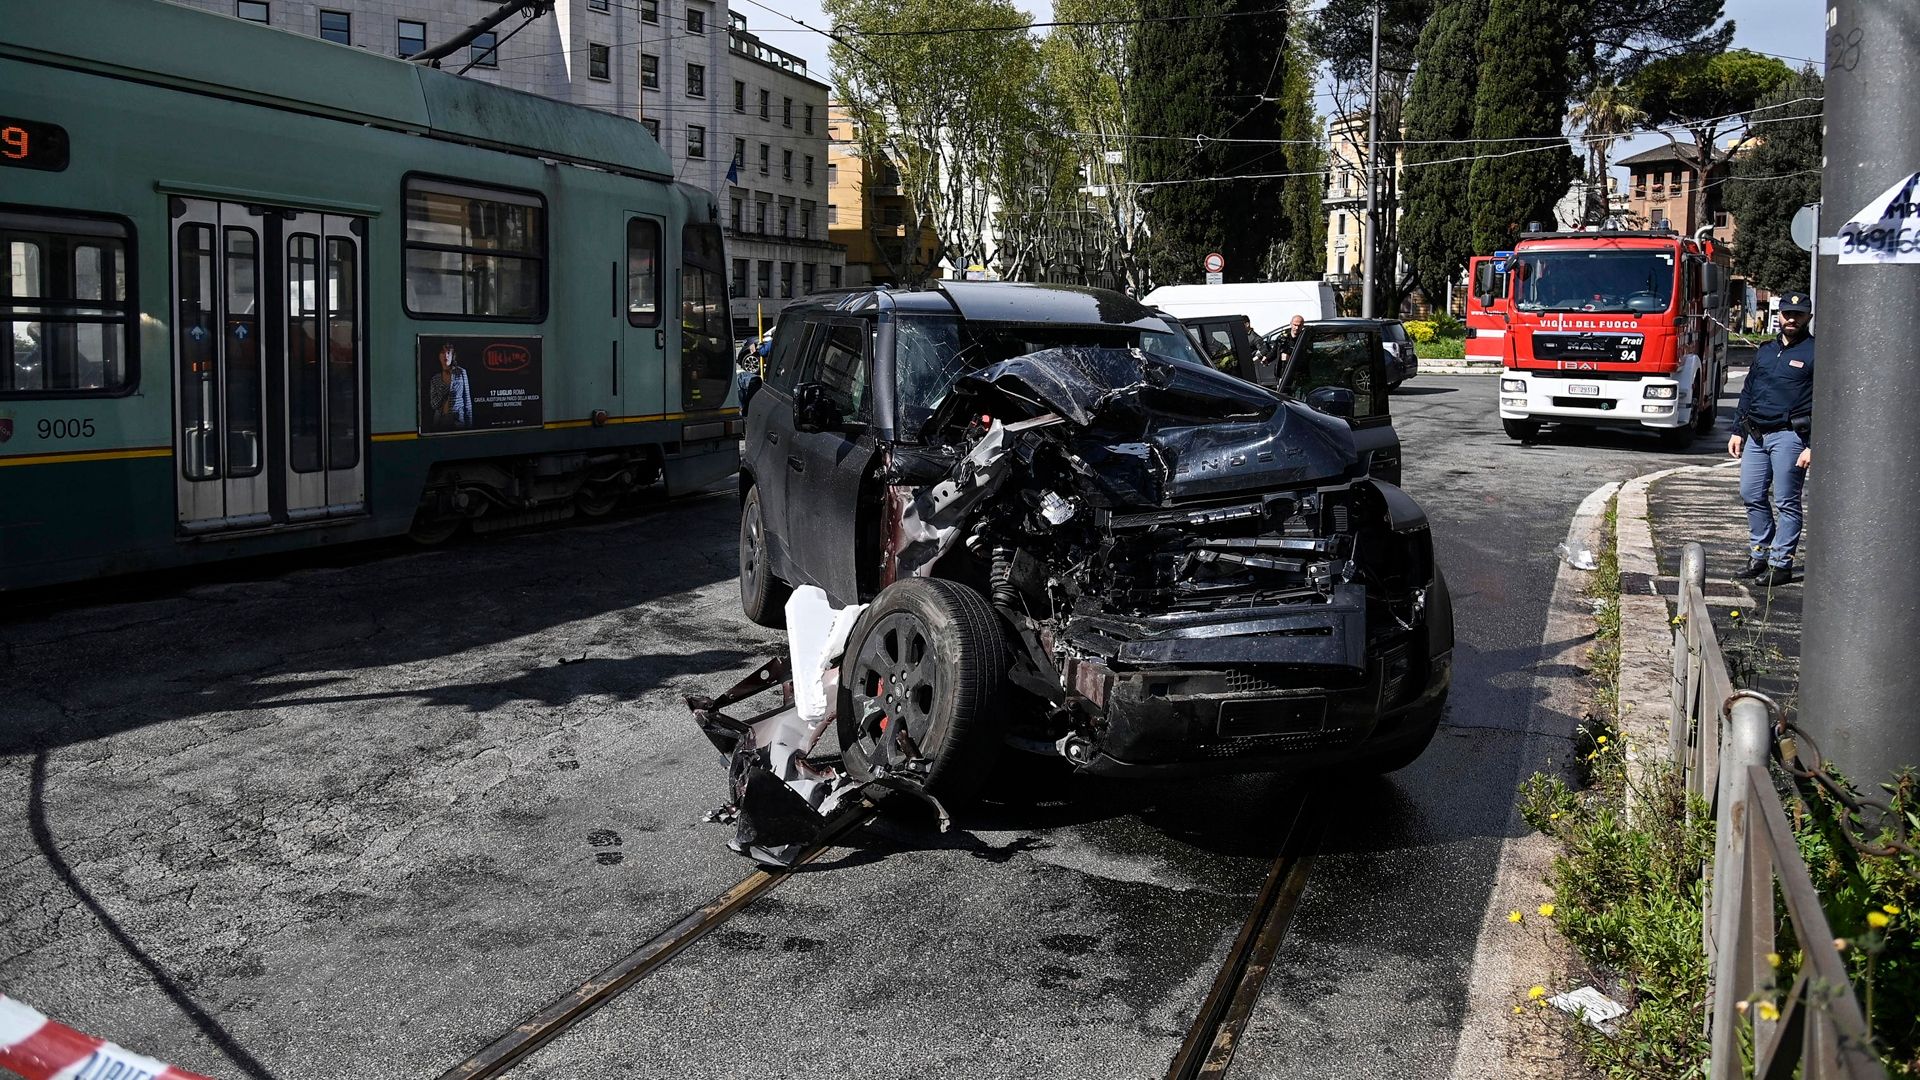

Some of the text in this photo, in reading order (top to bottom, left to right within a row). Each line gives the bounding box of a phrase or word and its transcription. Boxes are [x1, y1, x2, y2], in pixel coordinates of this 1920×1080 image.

[1, 126, 29, 159] 9
[1105, 153, 1122, 163] 257
[1540, 319, 1638, 329] VIGILI DEL FUOCO
[1567, 341, 1606, 351] MAN
[1620, 336, 1643, 346] Prati
[1620, 349, 1637, 361] 9A
[37, 418, 95, 439] 9005
